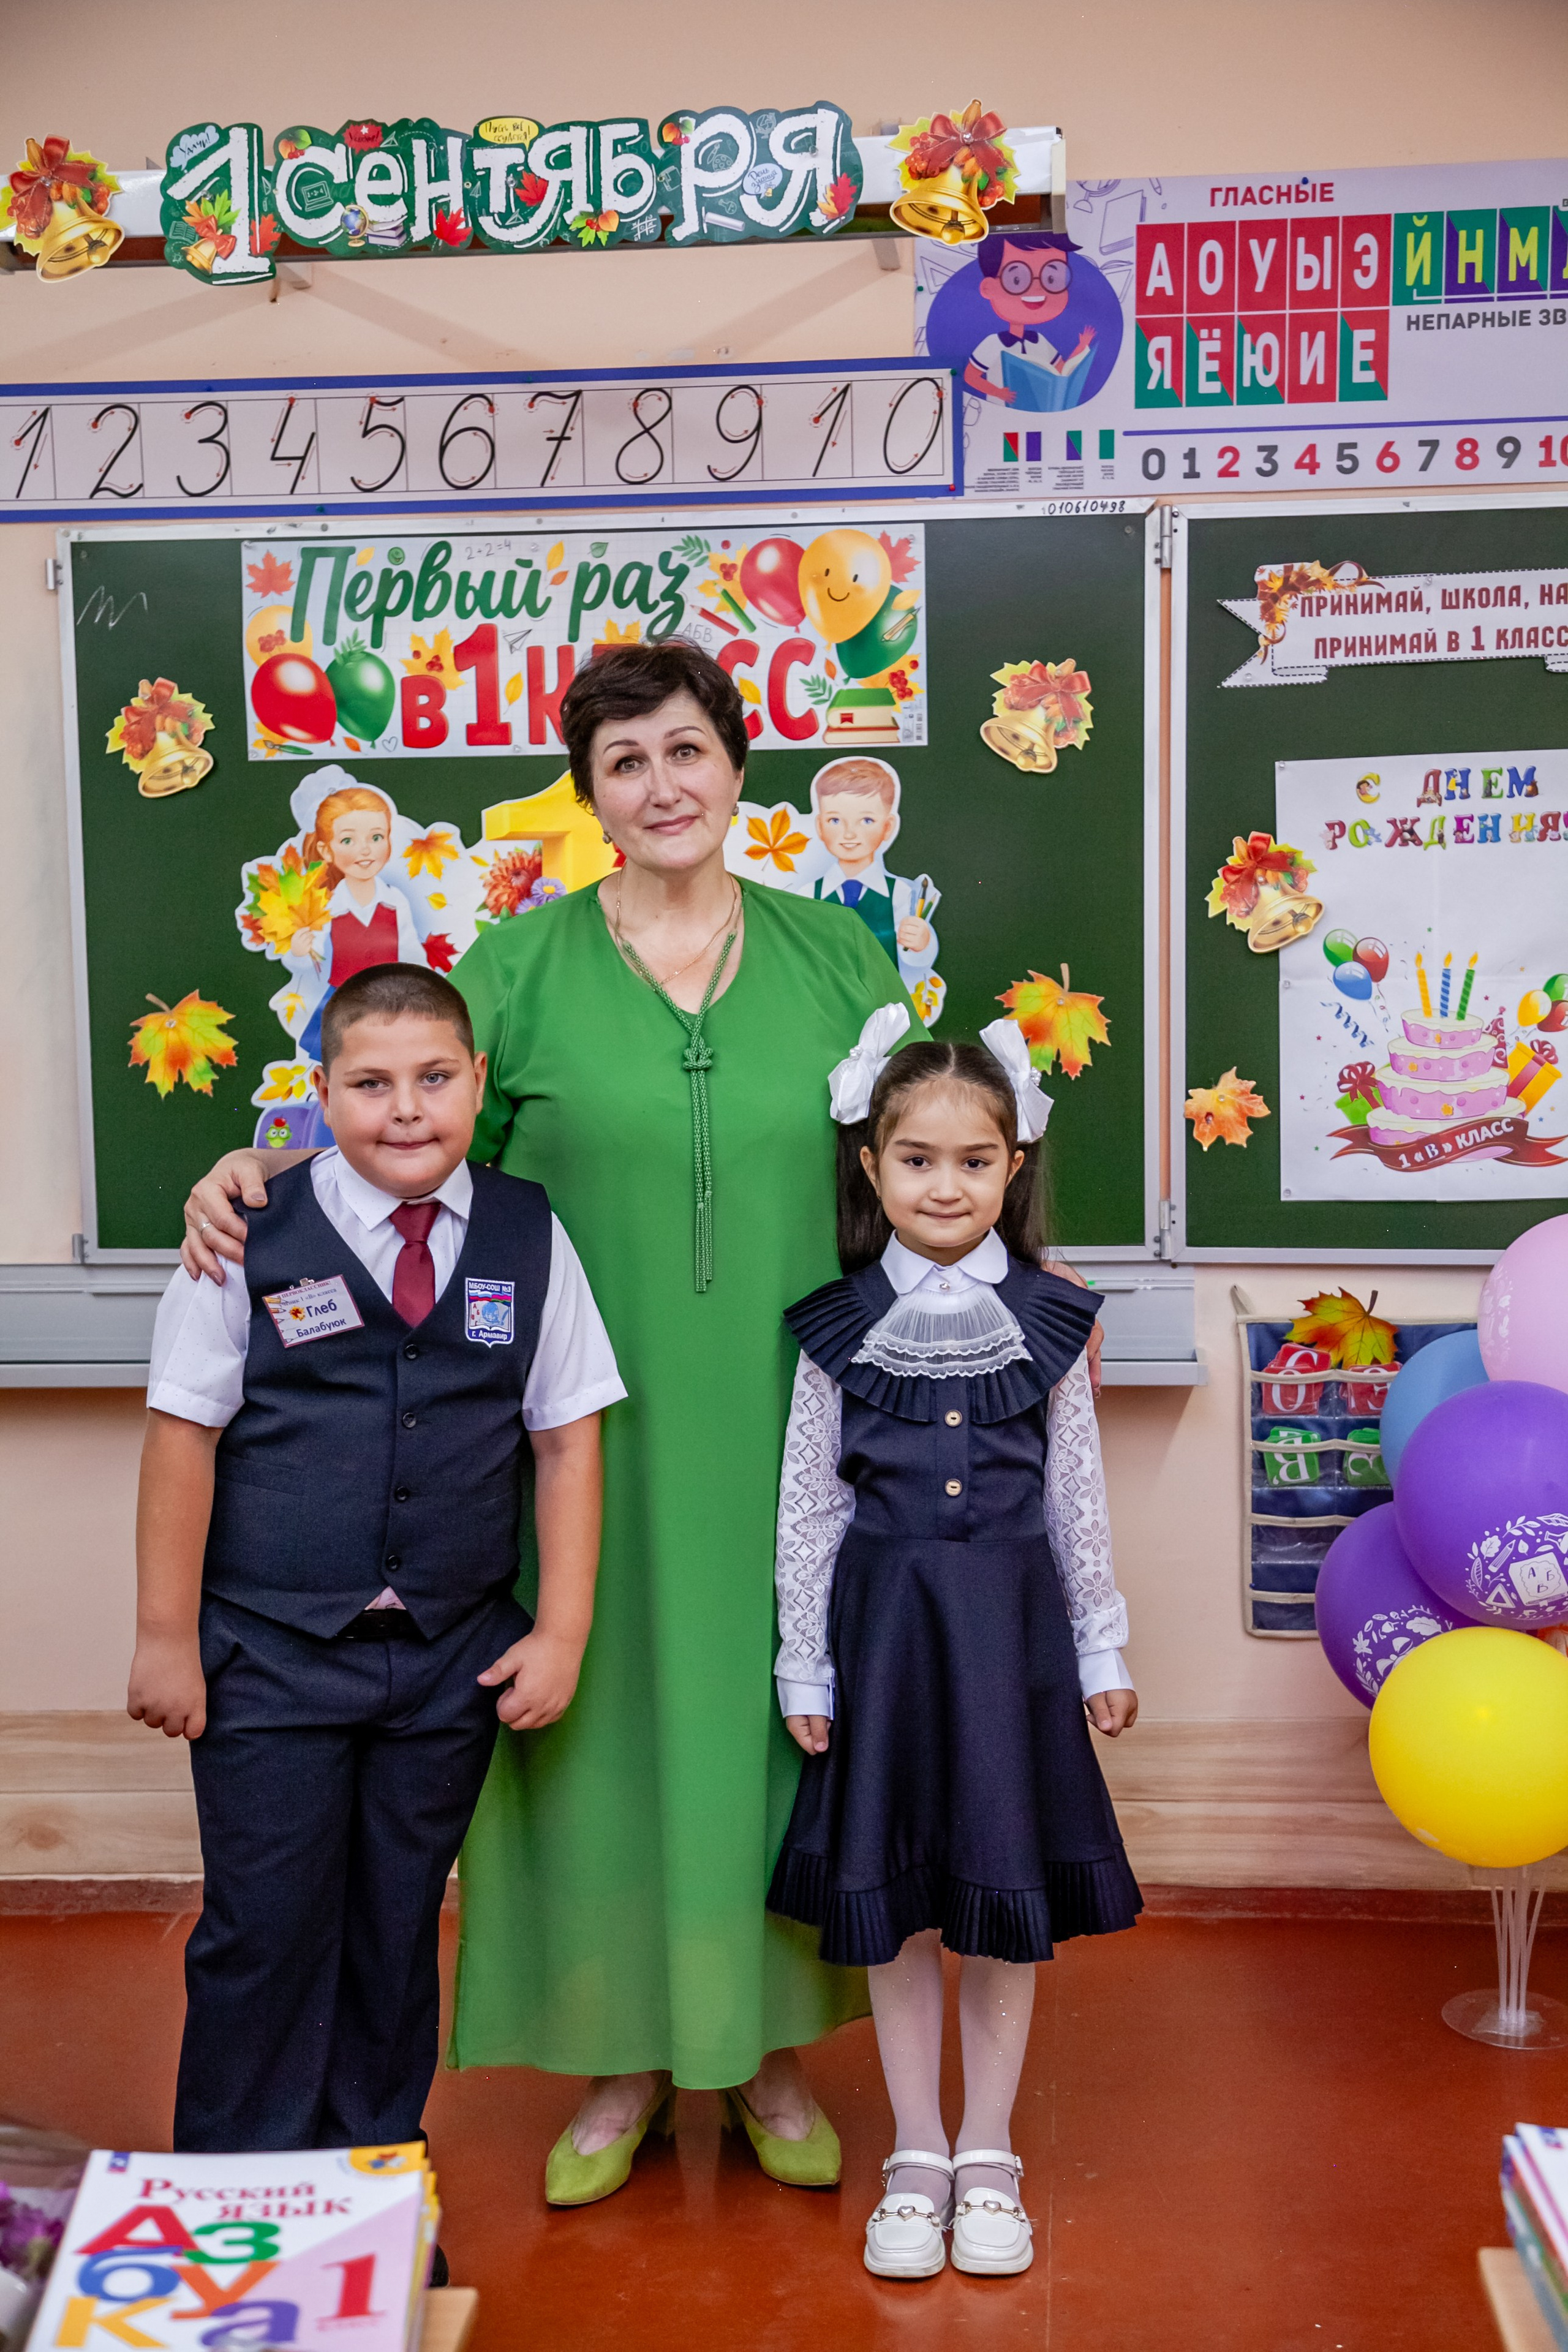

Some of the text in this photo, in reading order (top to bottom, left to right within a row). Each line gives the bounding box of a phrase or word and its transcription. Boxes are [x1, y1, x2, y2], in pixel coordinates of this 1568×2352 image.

[167, 126, 271, 275] 1
[1210, 182, 1336, 208] ГЛАСНЫЕ
[1146, 243, 1174, 297] А
[1197, 239, 1224, 296] О
[1250, 238, 1277, 293] У
[1295, 236, 1332, 291] Ы
[1352, 233, 1379, 290] Э
[1406, 214, 1432, 287] Й
[1457, 229, 1484, 284] Н
[1509, 226, 1539, 282] М
[1406, 309, 1532, 331] НЕПАРНЫЕ
[1147, 328, 1377, 394] Я Ё Ю И Е
[17, 407, 51, 499] 1
[89, 404, 144, 499] 2
[176, 401, 230, 497] 3
[270, 397, 316, 495] 4
[350, 396, 407, 492] 5
[439, 394, 495, 489] 6
[529, 390, 582, 488] 7
[615, 388, 673, 485] 8
[707, 385, 763, 481] 9
[1142, 448, 1166, 481] 0
[1182, 447, 1200, 480] 1
[1217, 446, 1242, 478] 2
[1255, 445, 1279, 478] 3
[1294, 443, 1321, 477] 4
[1336, 442, 1360, 475] 5
[1376, 440, 1401, 474] 6
[1417, 439, 1441, 473] 7
[1455, 437, 1481, 471] 8
[1496, 436, 1522, 470] 9
[290, 541, 690, 649] Первый раз
[1300, 586, 1431, 618] ПРИНИМАЙ,
[1441, 585, 1529, 610] ШКОЛА,
[1314, 625, 1568, 660] ПРИНИМАЙ В 1 КЛАСС
[453, 624, 512, 747] 1
[527, 638, 820, 746] КСС
[1355, 765, 1540, 808] С ДНЕМ
[1398, 1153, 1412, 1169] 1
[1455, 1118, 1515, 1149] КЛАСС
[306, 1298, 337, 1317] Глеб
[296, 1318, 347, 1338] Балабуюк
[478, 1330, 508, 1341] Армавир
[137, 2177, 315, 2204] Русский
[217, 2196, 353, 2221] язык
